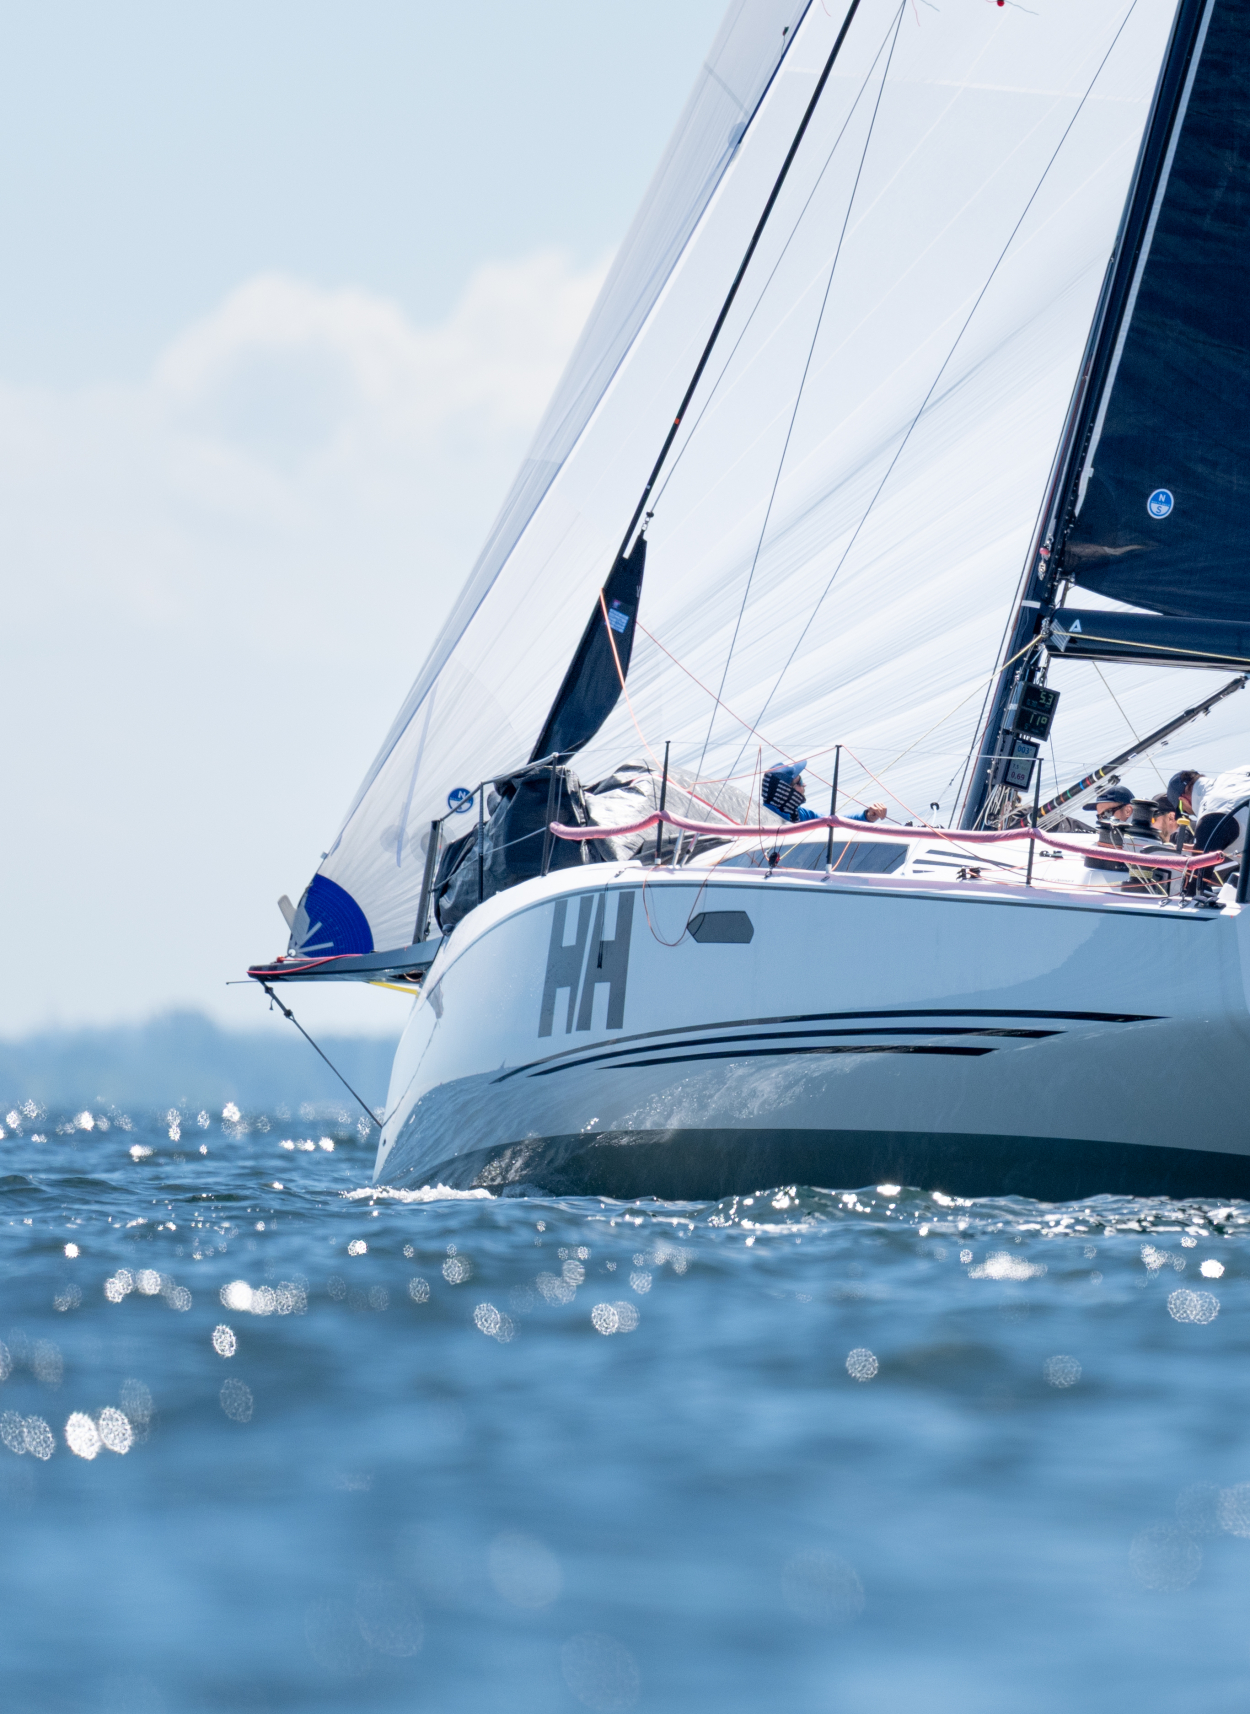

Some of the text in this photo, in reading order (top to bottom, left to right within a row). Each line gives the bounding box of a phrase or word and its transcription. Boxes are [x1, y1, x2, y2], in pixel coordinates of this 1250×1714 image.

[1158, 493, 1166, 502] N
[1155, 505, 1162, 514] S
[537, 890, 636, 1038] HH
